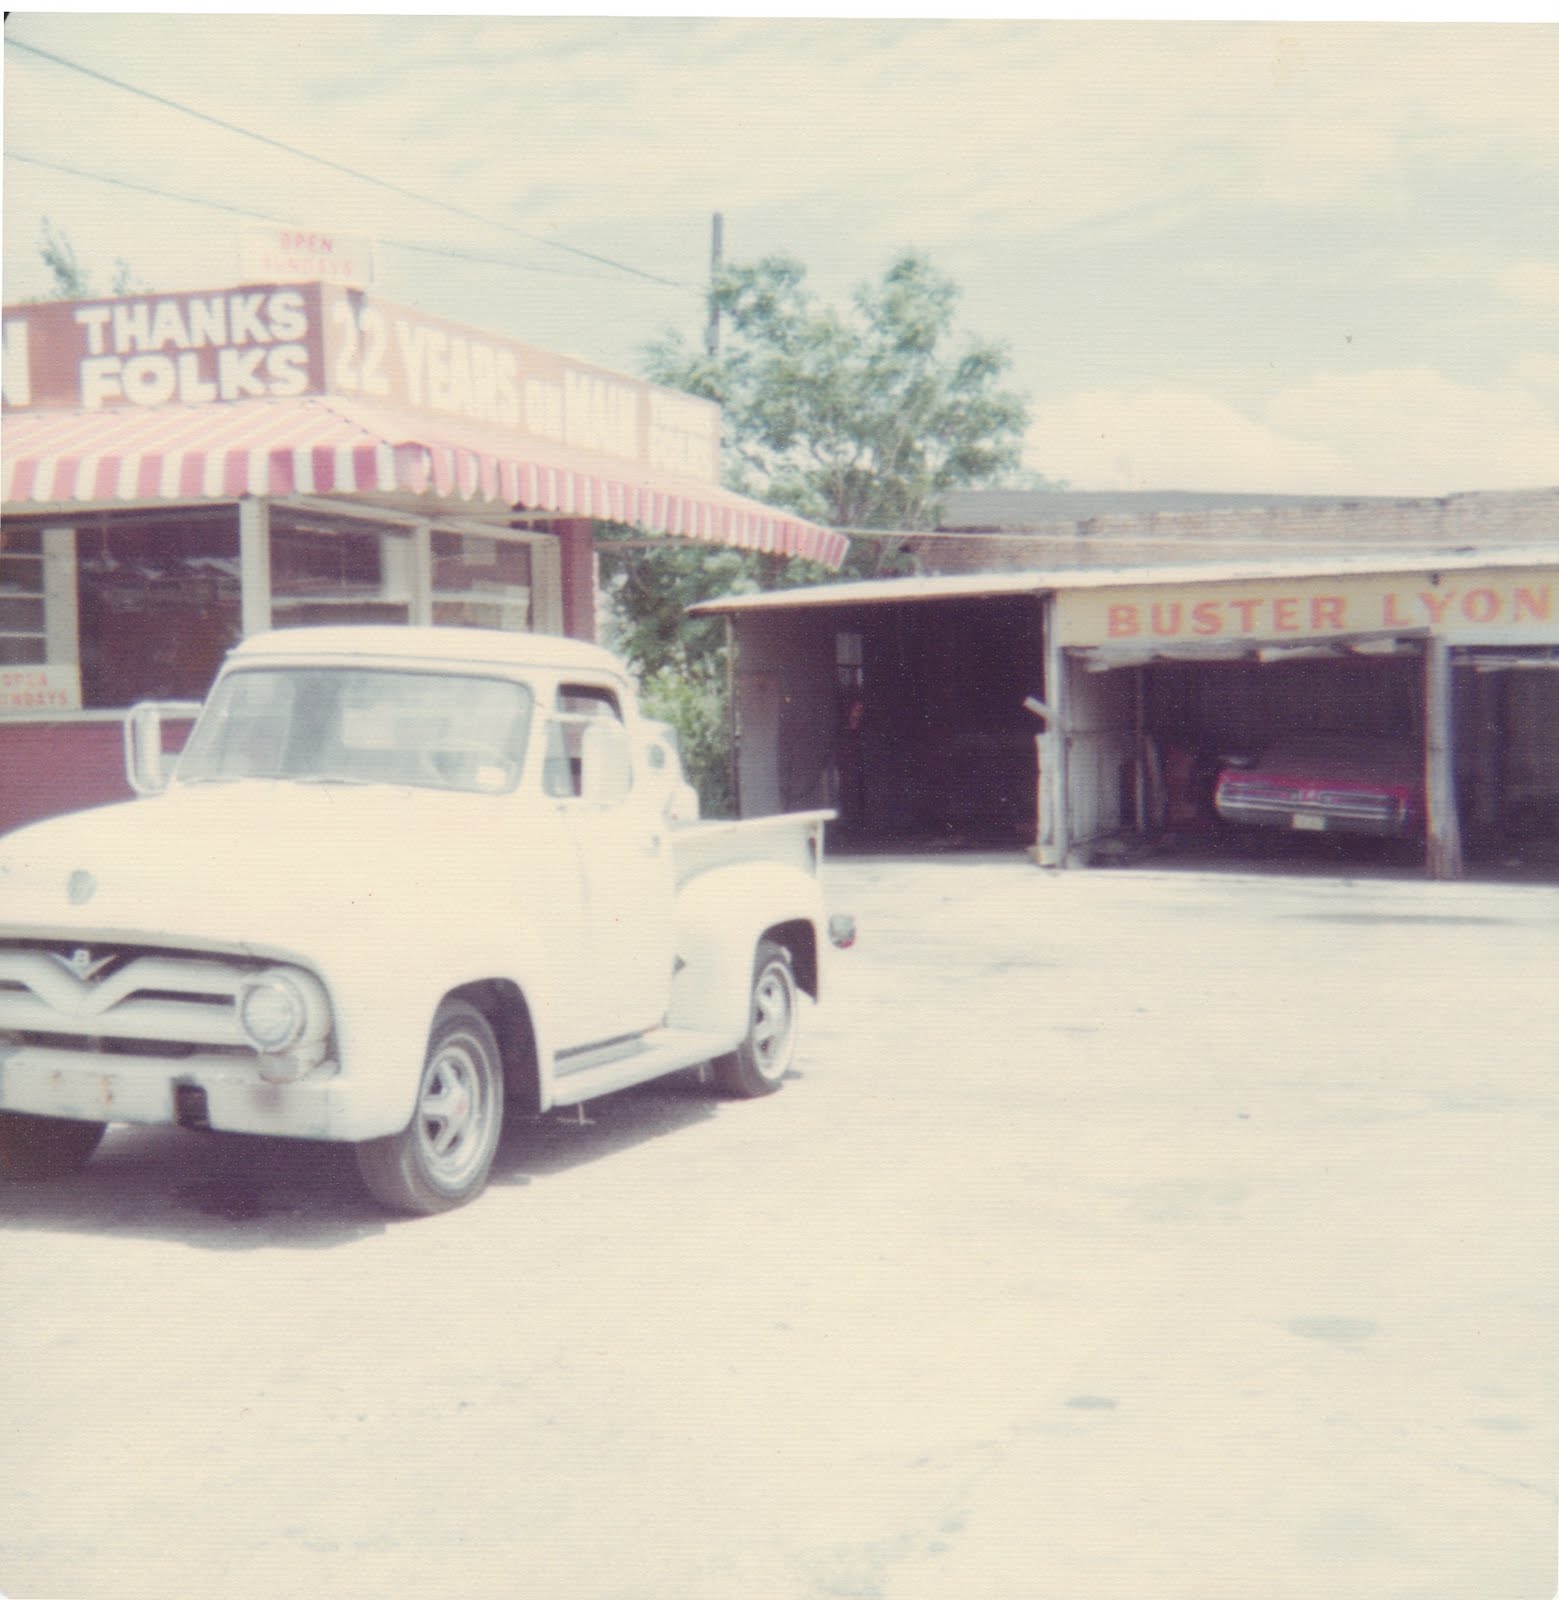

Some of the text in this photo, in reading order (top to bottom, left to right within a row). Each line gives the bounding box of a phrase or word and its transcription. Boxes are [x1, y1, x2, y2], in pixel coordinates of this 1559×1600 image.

[74, 289, 308, 354] THANKS
[80, 343, 310, 409] FOLKS
[330, 300, 392, 397] 22
[395, 319, 520, 428] YEARS
[1107, 585, 1552, 638] BUSTER LYON
